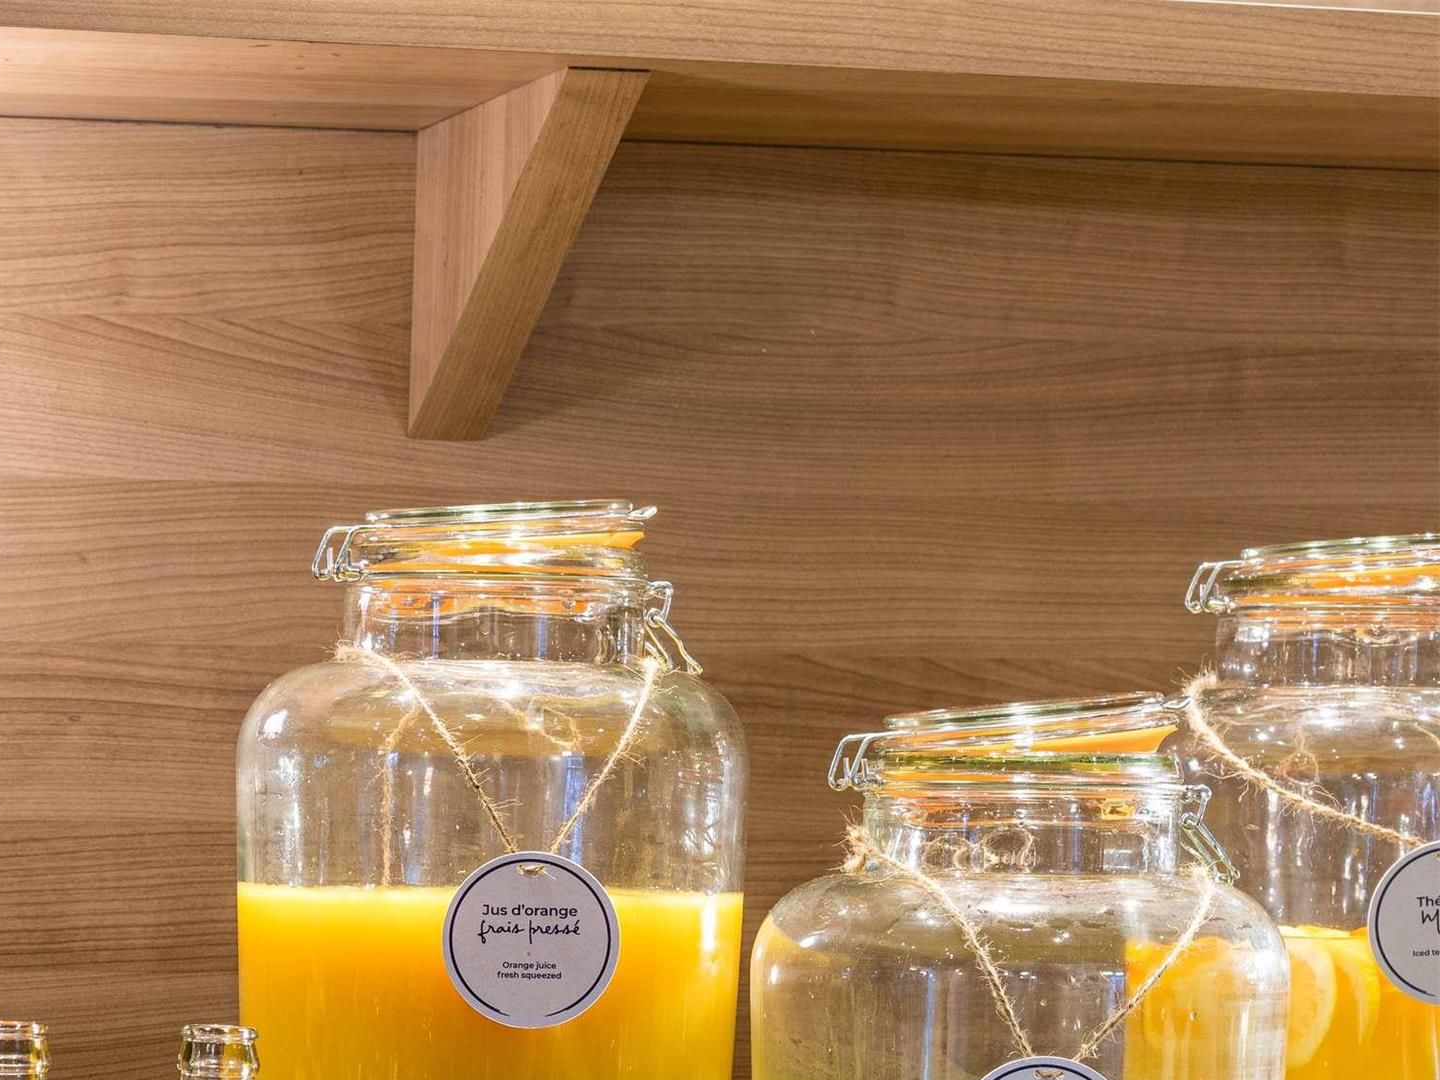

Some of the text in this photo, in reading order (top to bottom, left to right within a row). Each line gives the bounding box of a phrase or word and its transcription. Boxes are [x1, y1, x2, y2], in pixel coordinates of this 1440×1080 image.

[482, 903, 578, 920] Jus d'orange
[477, 919, 581, 945] frais pressé
[1412, 948, 1430, 957] Iced
[502, 961, 557, 971] Orange juice
[497, 971, 562, 981] fresh squeezed
